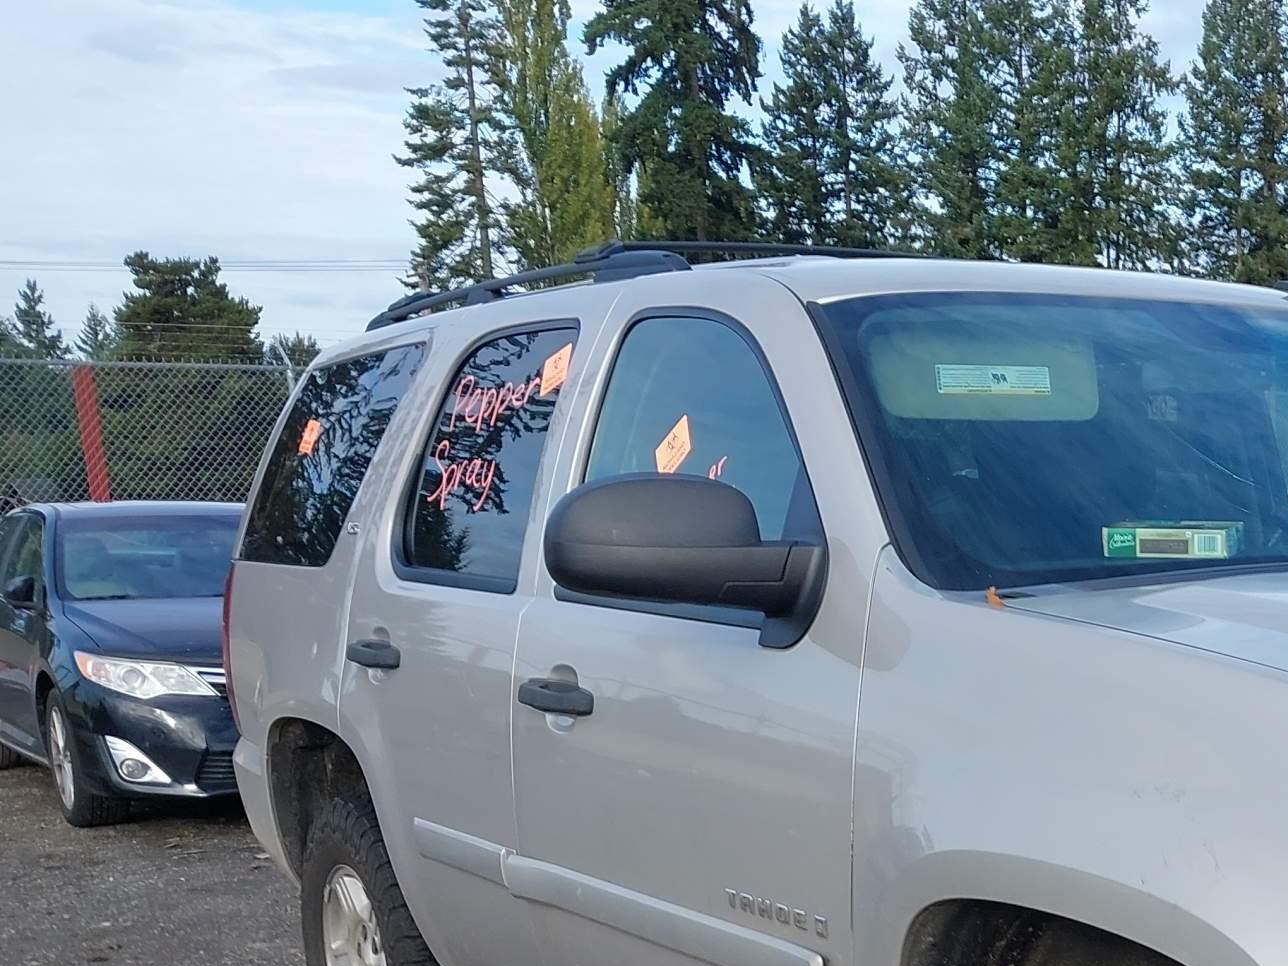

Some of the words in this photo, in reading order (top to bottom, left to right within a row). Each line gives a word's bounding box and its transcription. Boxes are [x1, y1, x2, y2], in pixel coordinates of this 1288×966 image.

[450, 375, 541, 432] Pepper
[426, 439, 496, 511] Spray
[724, 887, 809, 932] TAHOE
